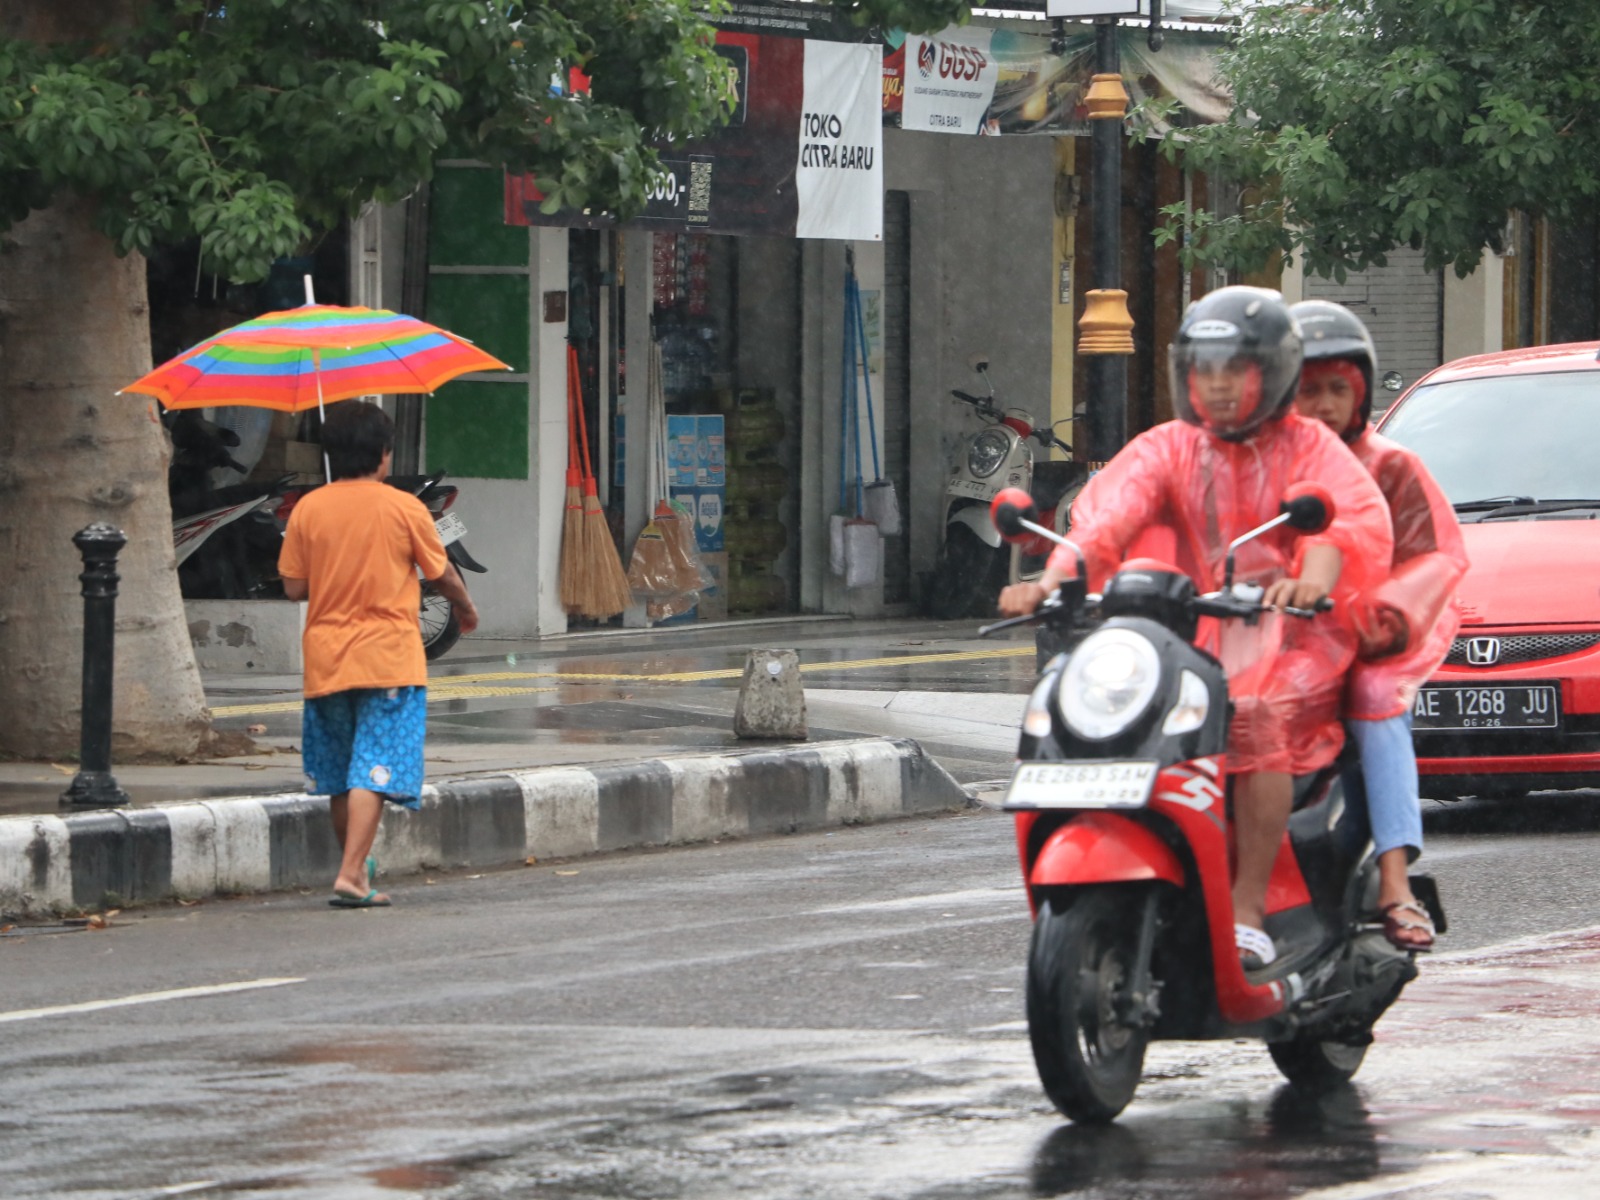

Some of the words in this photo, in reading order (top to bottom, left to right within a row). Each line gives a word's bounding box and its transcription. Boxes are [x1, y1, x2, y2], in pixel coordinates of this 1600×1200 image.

[940, 42, 987, 81] GGSP
[804, 113, 842, 138] TOKO
[801, 143, 838, 168] CITRA
[841, 145, 874, 170] BARU
[1415, 691, 1440, 716] AE
[1455, 690, 1506, 715] 1268
[1522, 689, 1548, 714] JU
